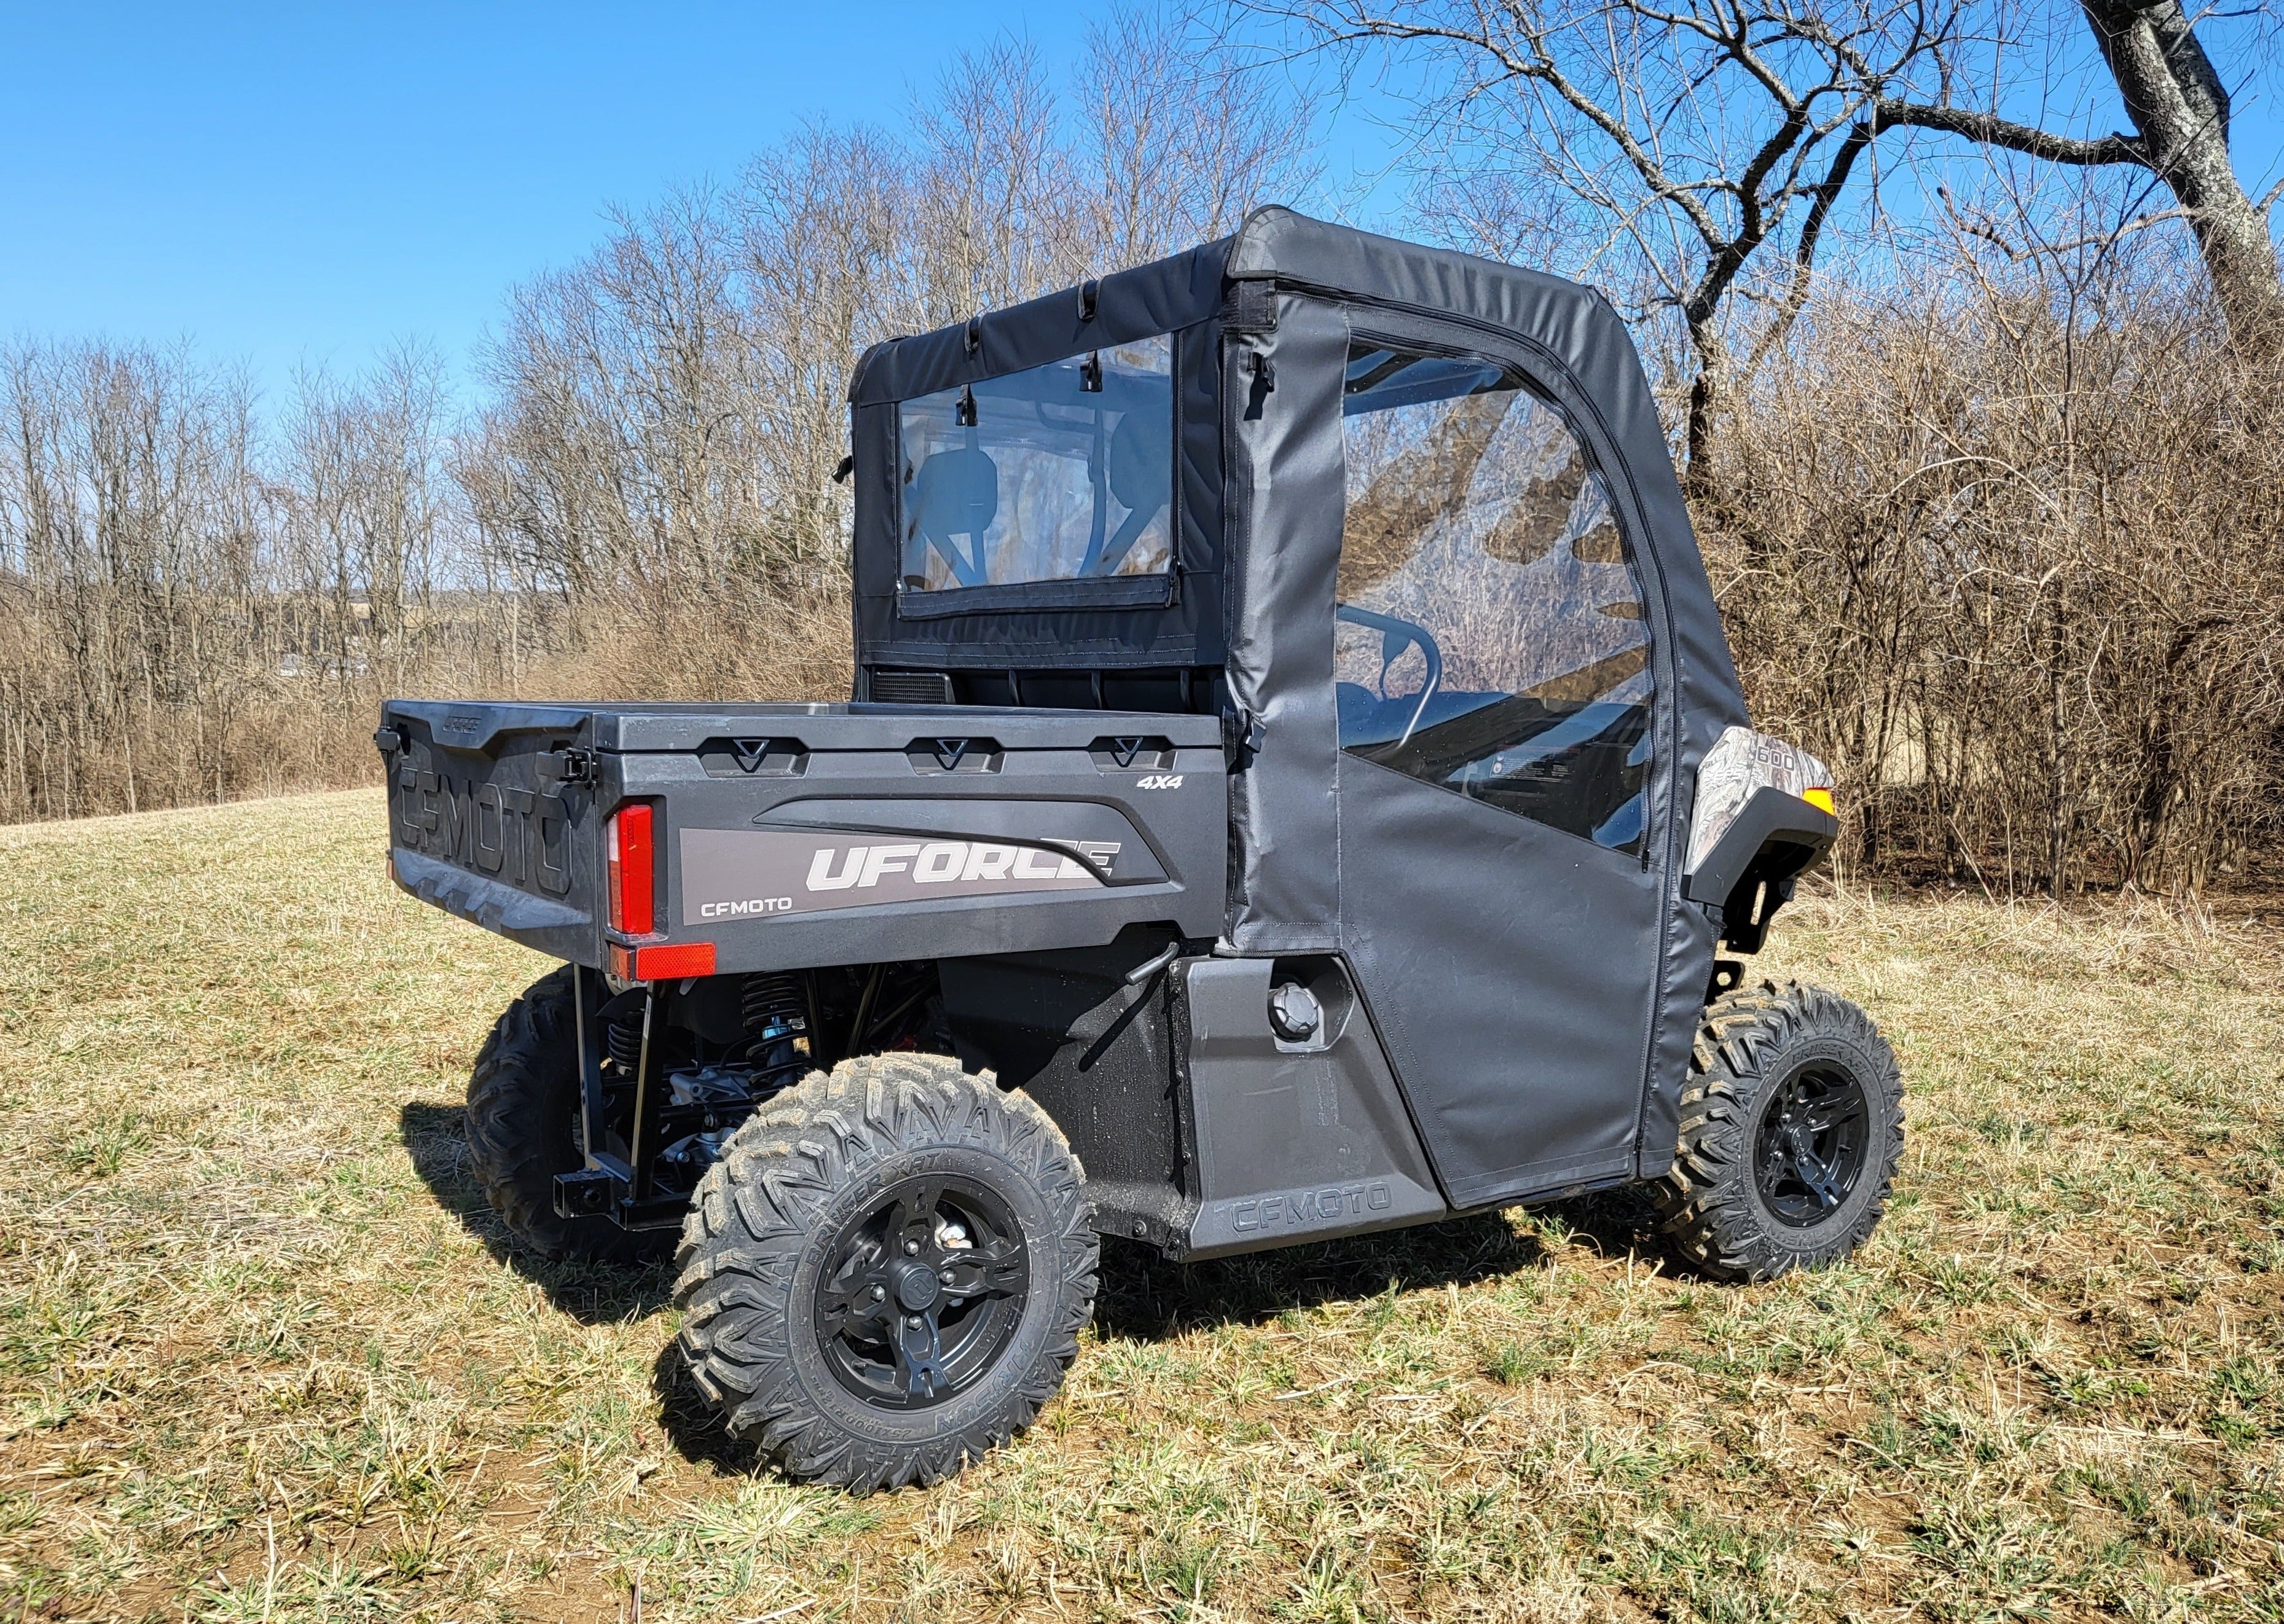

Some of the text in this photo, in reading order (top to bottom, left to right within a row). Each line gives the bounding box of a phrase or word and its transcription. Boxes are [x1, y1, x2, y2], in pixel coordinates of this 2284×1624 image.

[1756, 744, 1795, 772] 600
[1137, 775, 1184, 790] 4X4
[399, 767, 573, 896] CFMOTO
[806, 838, 1121, 892] UFORCE
[701, 897, 792, 917] CFMOTO
[1231, 1182, 1392, 1232] CFMOTO
